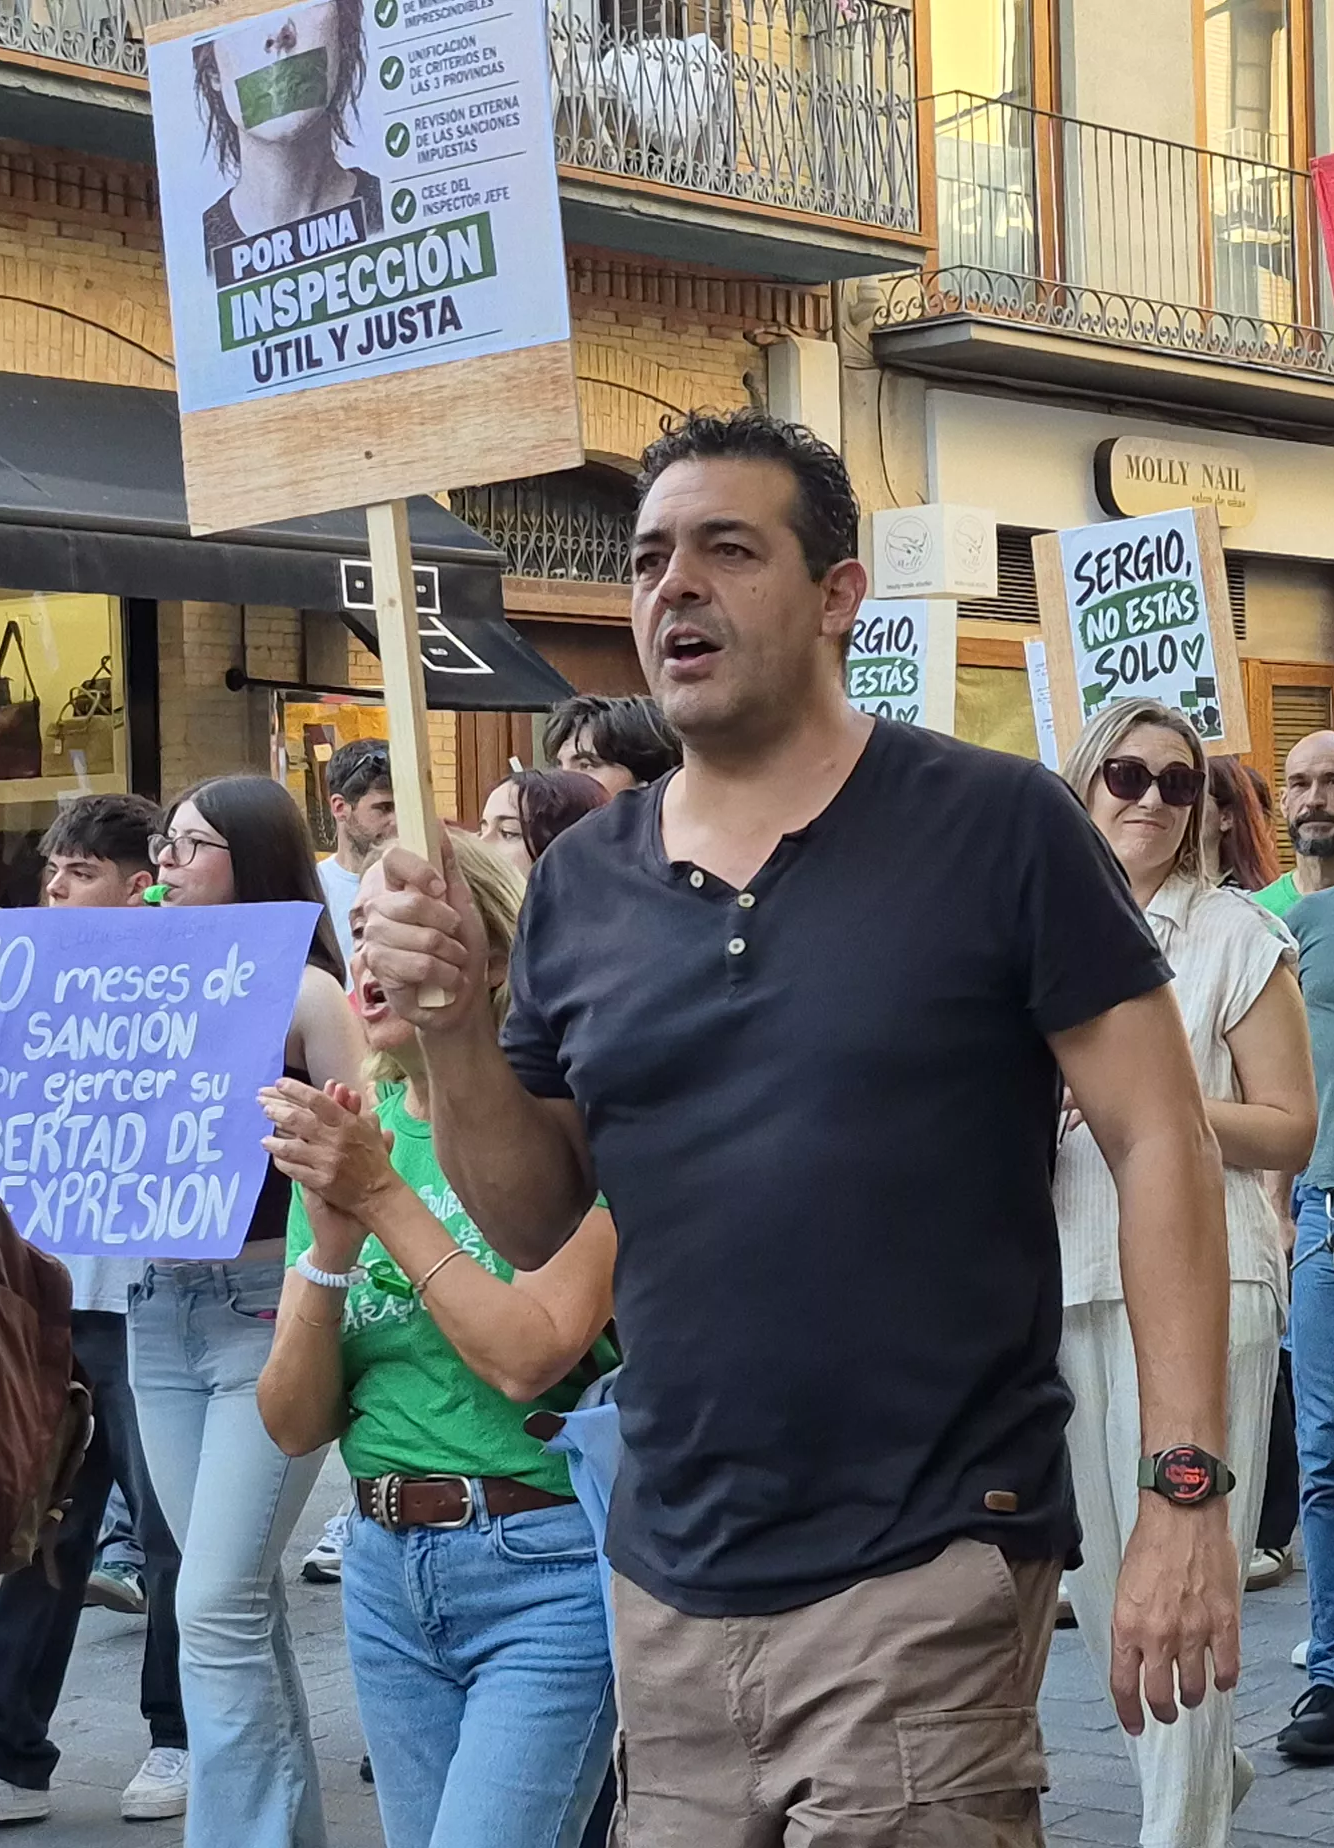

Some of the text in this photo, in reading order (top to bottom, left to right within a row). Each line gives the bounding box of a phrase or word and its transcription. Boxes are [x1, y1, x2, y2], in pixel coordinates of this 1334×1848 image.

[409, 46, 497, 79] DE CRITERIOS EN
[411, 61, 505, 95] LAS 3 PROVINCIAS
[416, 112, 520, 148] DE LAS SANCIONES
[469, 95, 520, 118] EXTERNA
[418, 138, 478, 164] IMPUESTAS
[421, 177, 471, 200] CESE DEL
[423, 187, 510, 217] INSPECTOR JEFE
[231, 209, 358, 280] POR UNA
[230, 224, 484, 341] INSPECCIÓN
[252, 295, 463, 384] ÚTIL Y JUSTA
[1125, 454, 1246, 493] MOLLY NAIL
[1074, 529, 1192, 607] SERGIO,
[1086, 582, 1195, 646] NO ESTÁS
[850, 658, 915, 697] ESTÁS
[1095, 634, 1179, 694] SOLO
[53, 963, 190, 1004] meses
[202, 942, 257, 1007] de
[23, 1003, 198, 1062] SANCIÓN
[43, 1068, 177, 1125] ejercer
[189, 1071, 231, 1102] su
[167, 1105, 225, 1166] DE
